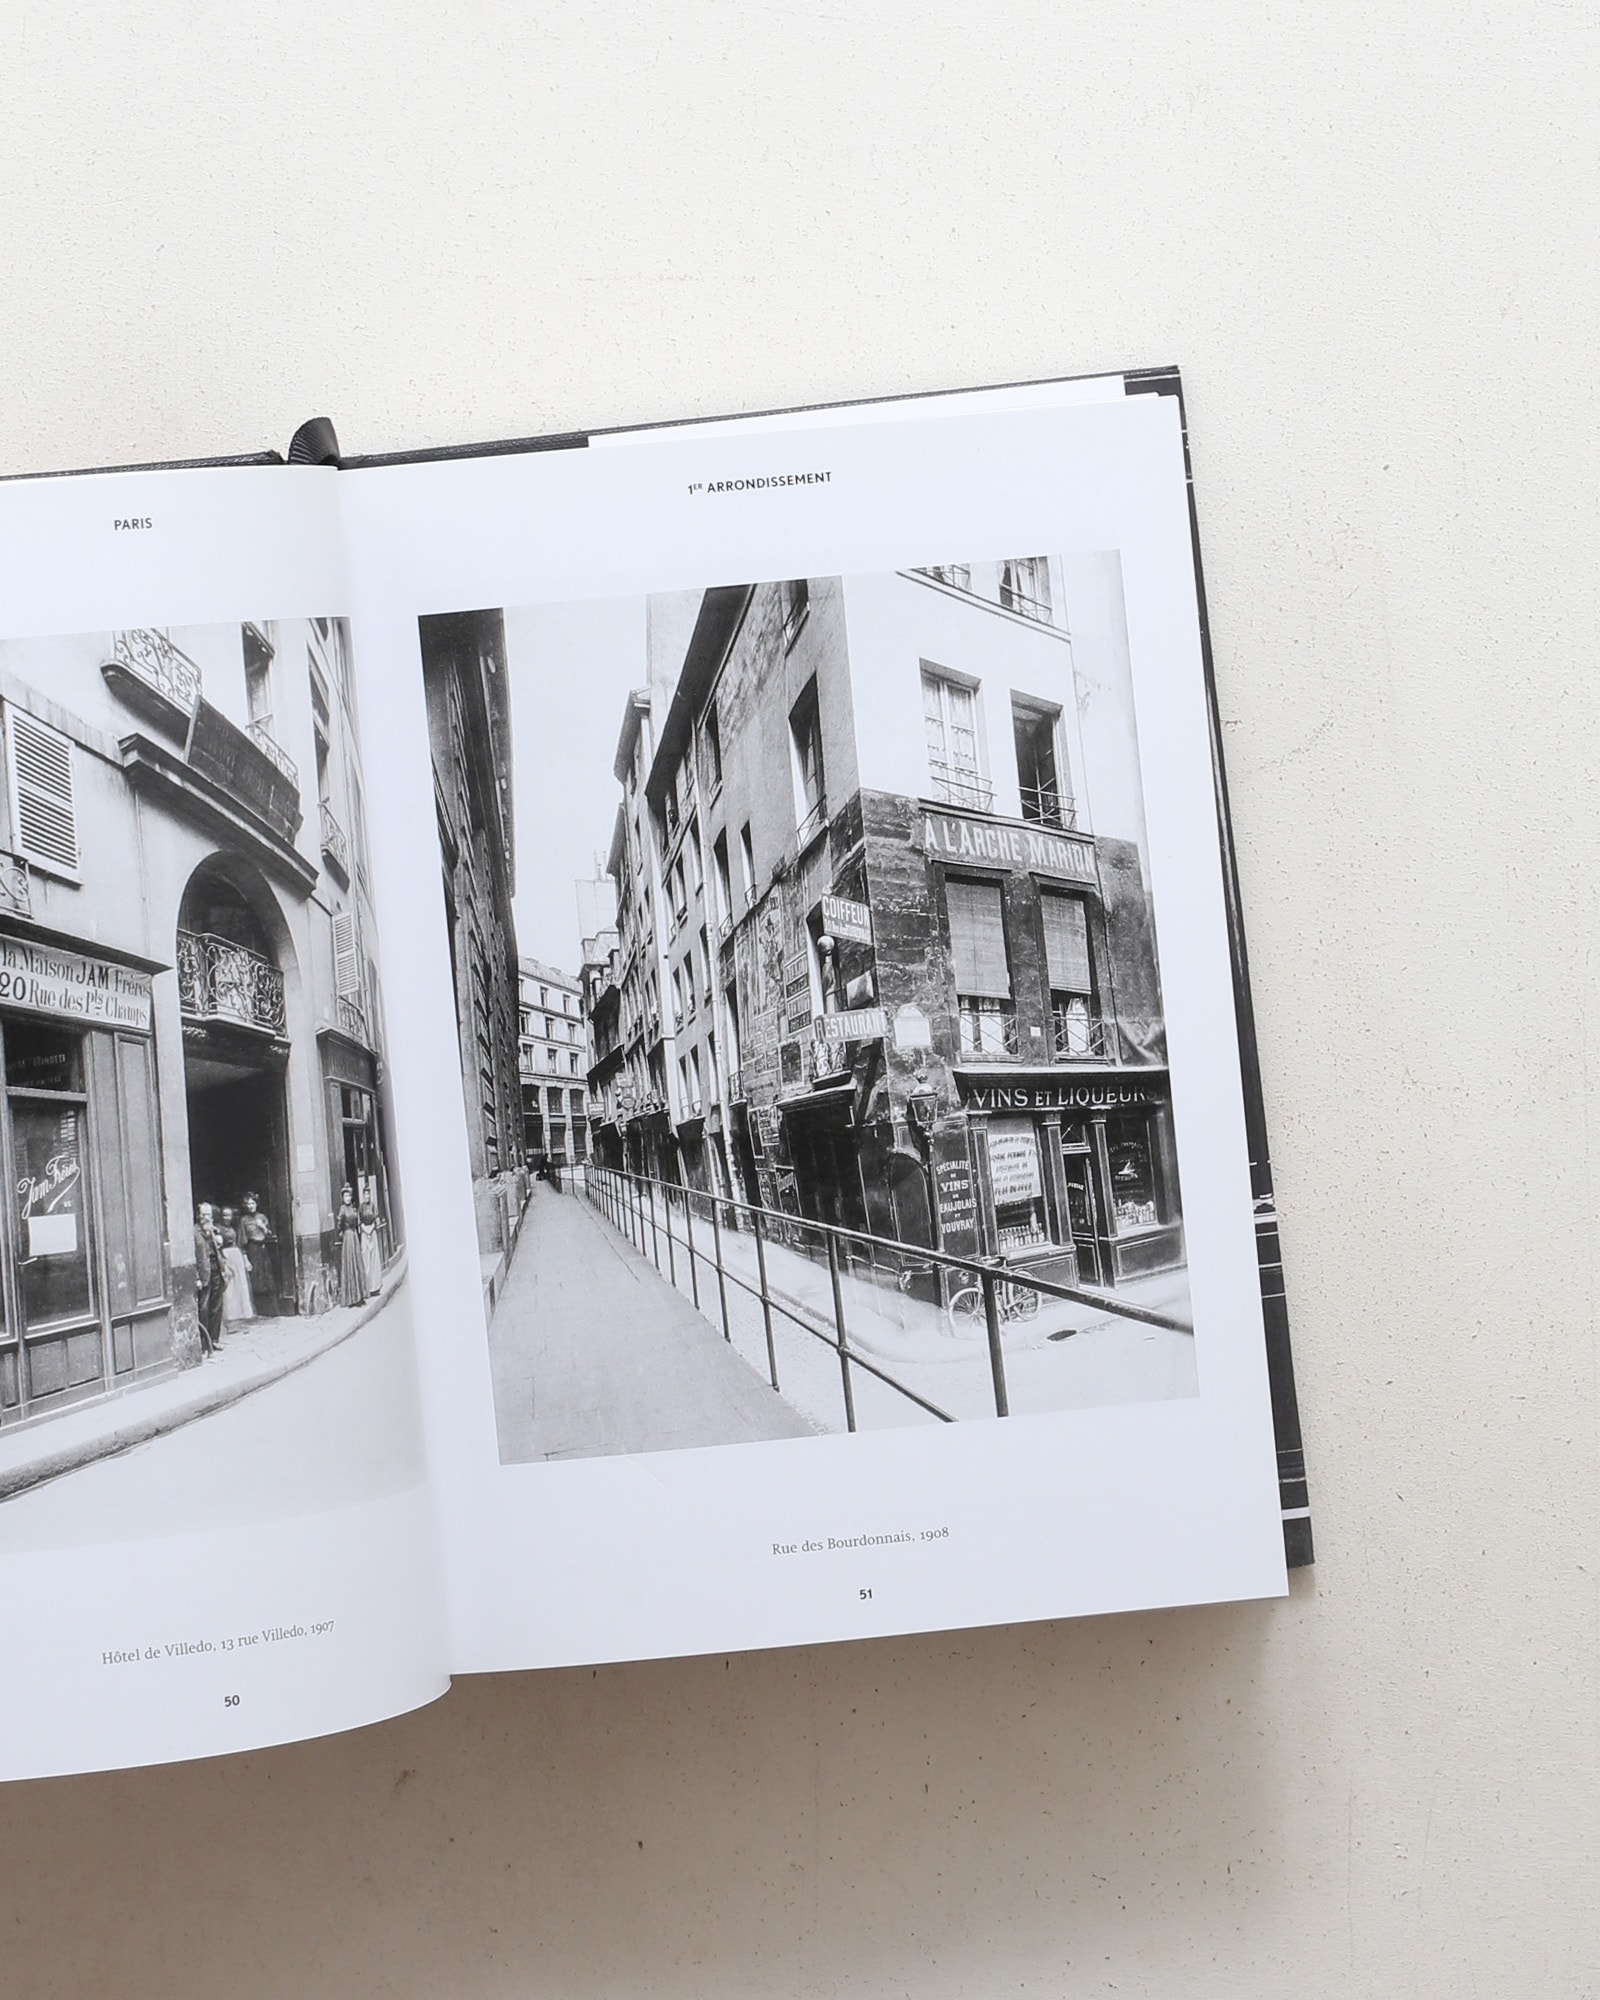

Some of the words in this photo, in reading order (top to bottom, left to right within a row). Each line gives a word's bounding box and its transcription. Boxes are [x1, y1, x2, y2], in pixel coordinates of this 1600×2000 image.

[706, 471, 832, 494] ARRONDISSEMENT
[114, 517, 153, 531] PARIS
[942, 819, 1023, 862] L'ARCHE
[1027, 832, 1097, 878] MARION
[822, 895, 870, 928] COIFFEUR
[19, 944, 74, 983] Maison
[75, 961, 110, 991] JAM
[0, 971, 27, 1001] 20
[28, 978, 57, 1009] Rue
[59, 987, 83, 1013] des
[105, 995, 148, 1027] Champs
[814, 1010, 887, 1041] RESTAURANT
[973, 1087, 1029, 1109] VINS
[1035, 1090, 1052, 1107] ET
[940, 1179, 970, 1193] VINS
[940, 1217, 975, 1235] VOUVRAY
[772, 1543, 798, 1556] Rue
[801, 1540, 824, 1553] des
[827, 1530, 916, 1551] Bourdonnais,
[919, 1526, 950, 1542] 1908
[859, 1588, 873, 1601] 51
[102, 1648, 141, 1666] Hôtel
[144, 1646, 162, 1661] de
[164, 1639, 217, 1658] Villedo,
[220, 1639, 235, 1652] 13
[237, 1634, 259, 1648] rue
[261, 1625, 308, 1643] Villedo,
[310, 1620, 336, 1637] 1907
[224, 1694, 241, 1708] 50
